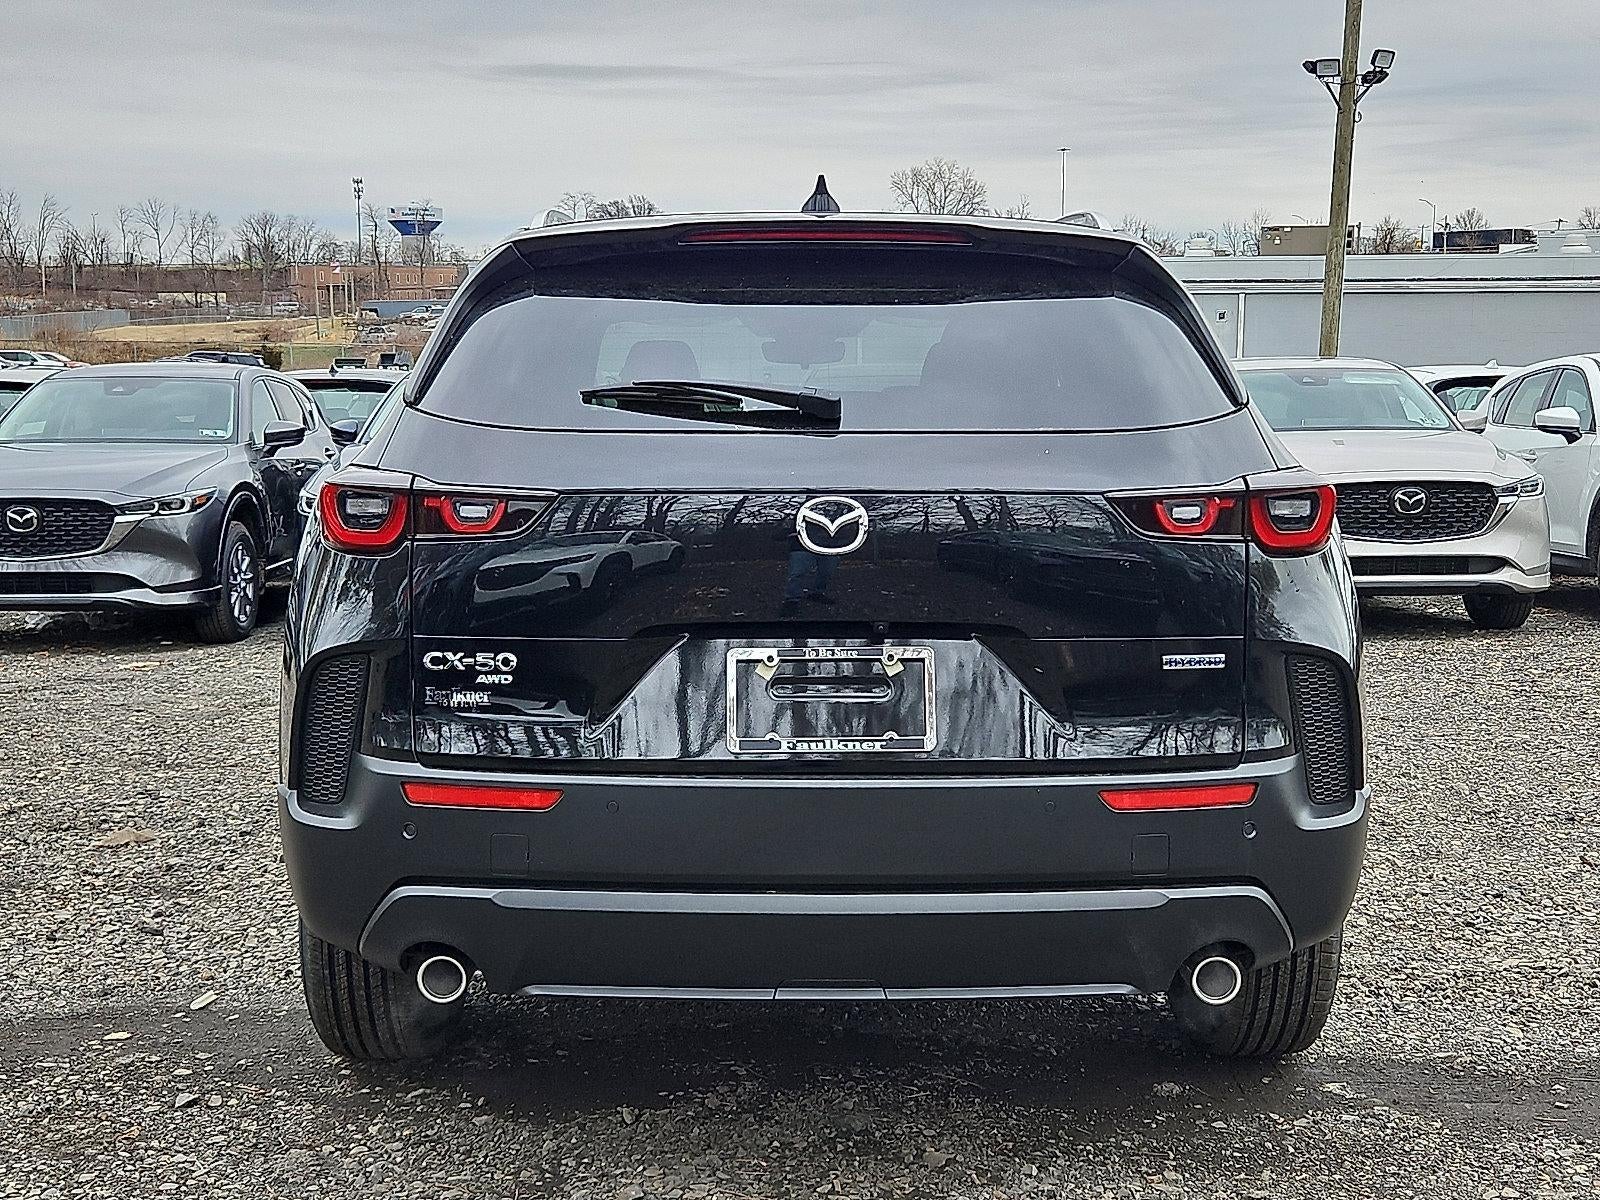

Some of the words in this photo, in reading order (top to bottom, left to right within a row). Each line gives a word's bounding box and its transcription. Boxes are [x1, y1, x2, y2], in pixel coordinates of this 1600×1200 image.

[802, 648, 817, 658] To
[819, 648, 833, 658] Be
[834, 648, 858, 658] Sure
[422, 651, 518, 672] CX-50
[1167, 656, 1223, 668] HYBRID
[474, 674, 514, 684] AWD
[779, 739, 887, 751] Faulkner
